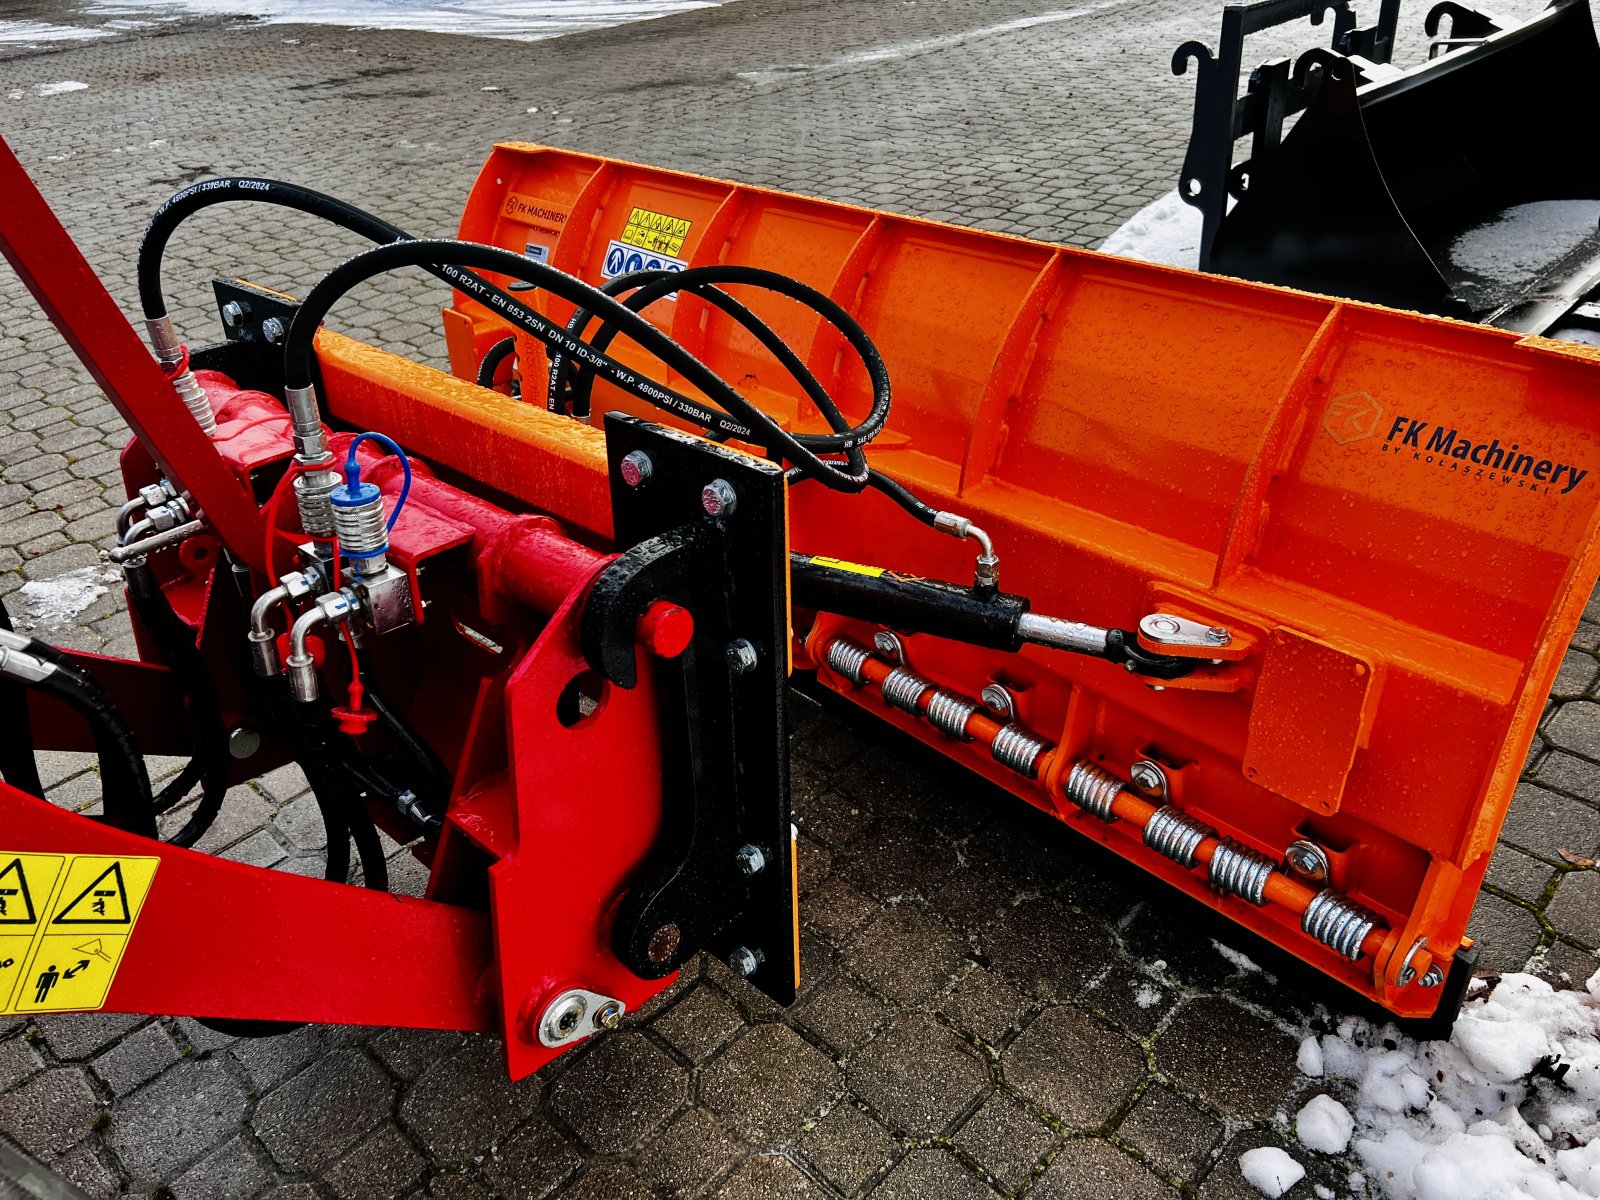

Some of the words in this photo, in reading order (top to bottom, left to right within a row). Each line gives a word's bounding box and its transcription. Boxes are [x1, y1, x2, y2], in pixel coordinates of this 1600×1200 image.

[238, 180, 270, 191] Q2/2024
[441, 263, 459, 278] 100
[458, 274, 487, 294] R2AT
[491, 295, 507, 309] EN
[506, 304, 524, 319] 853
[524, 315, 546, 332] 2SN
[547, 329, 564, 344] DN
[565, 340, 576, 351] 10
[616, 369, 636, 387] W.P.
[637, 382, 673, 405] 4800PSI
[677, 402, 712, 423] 330BAR
[719, 419, 751, 436] Q2/2024
[553, 353, 562, 367] 100
[549, 369, 559, 391] R2AT
[548, 398, 555, 410] EN
[1381, 444, 1402, 454] BY
[1386, 416, 1429, 448] FK
[1424, 426, 1589, 495] Machinery
